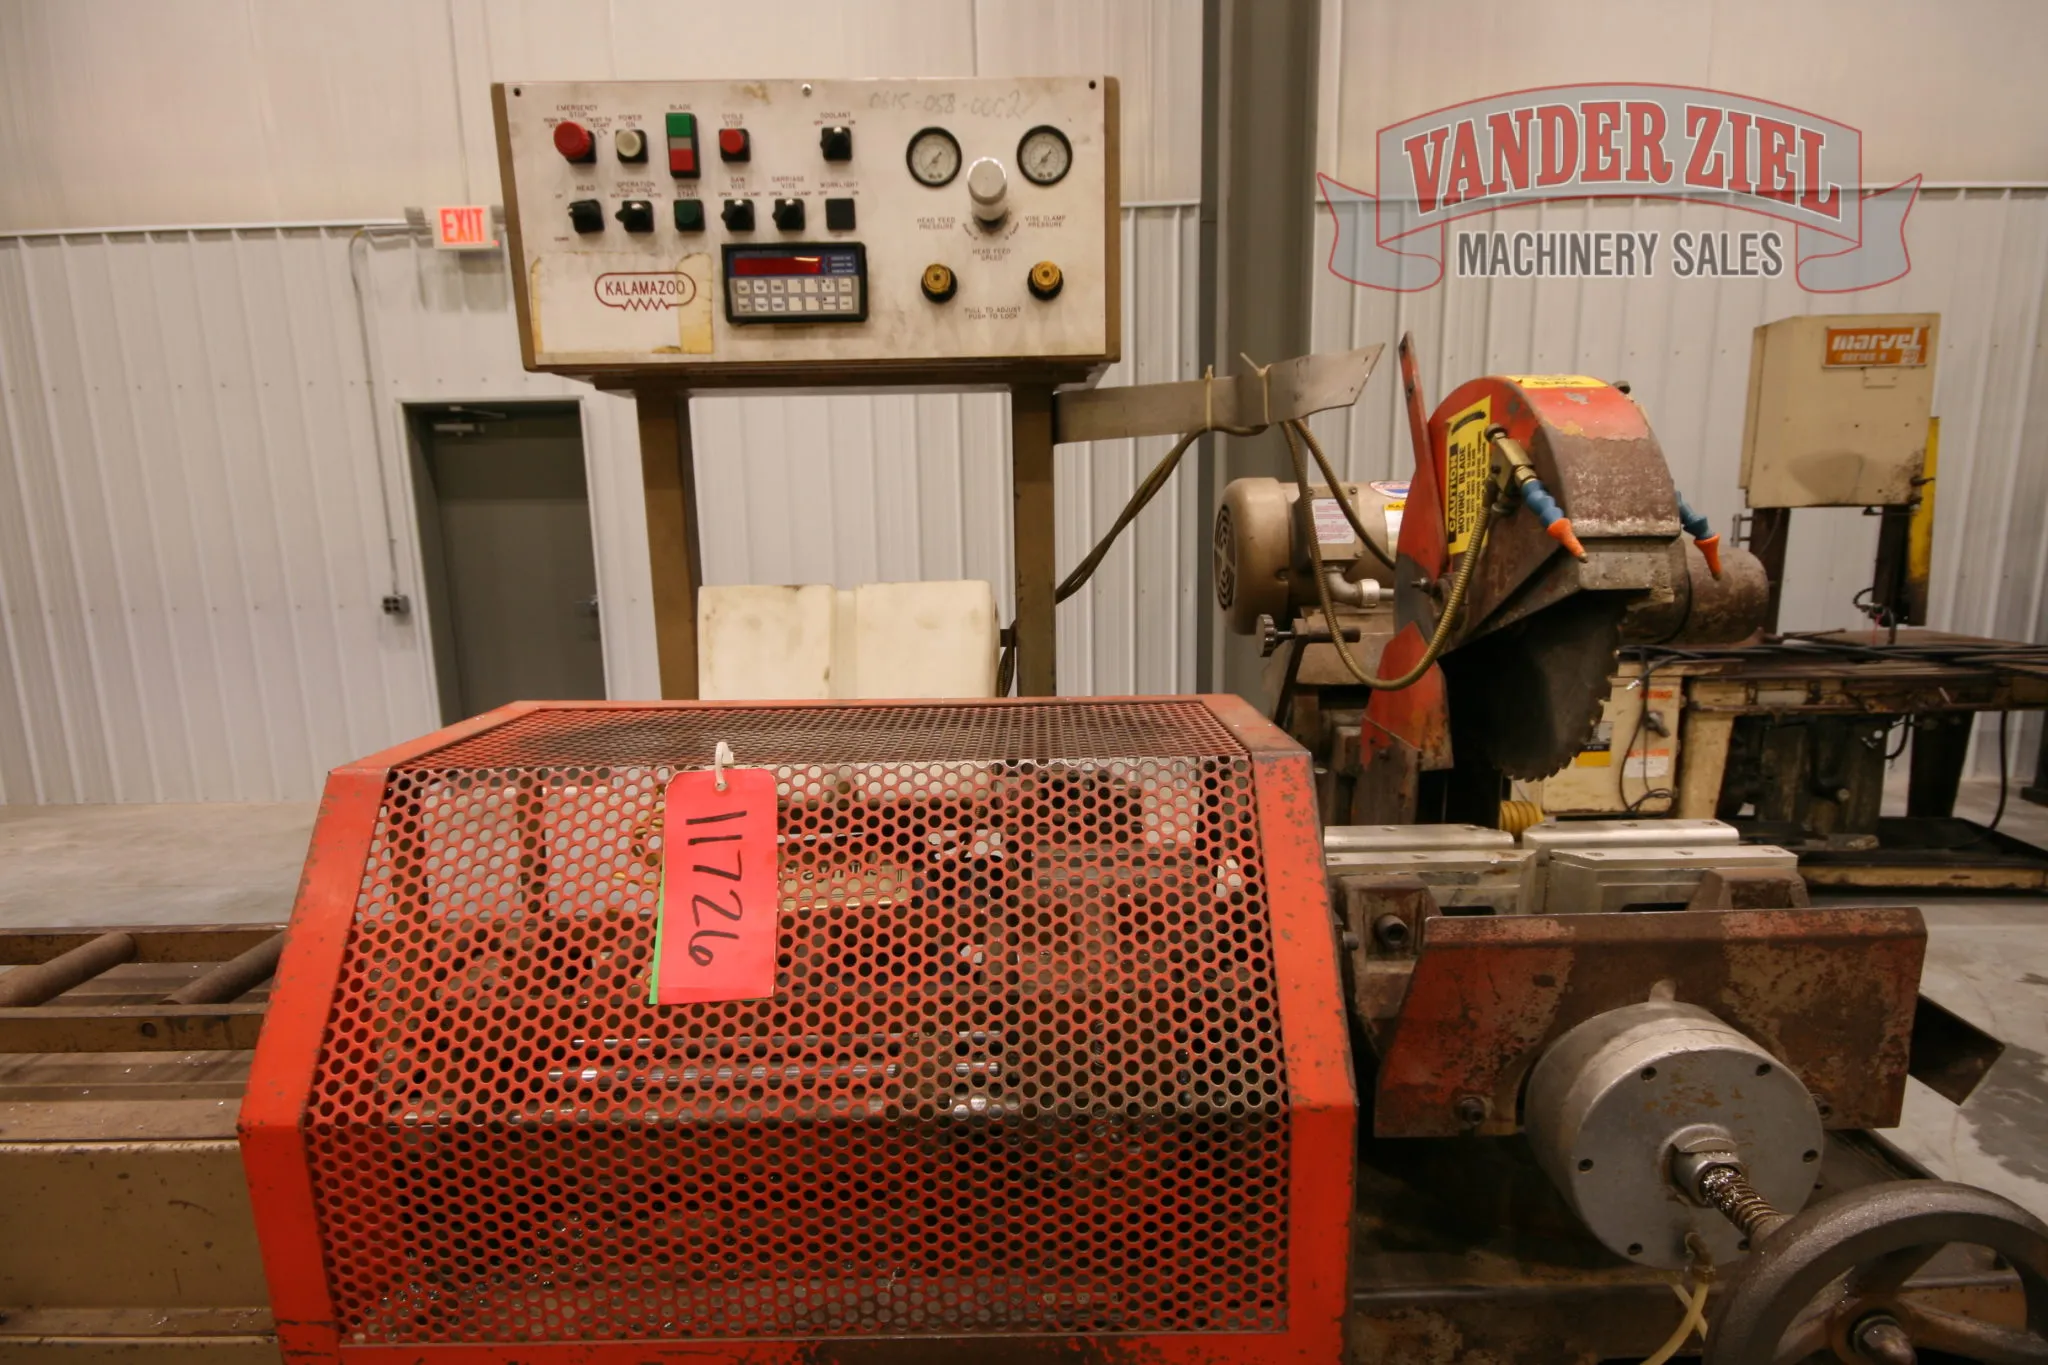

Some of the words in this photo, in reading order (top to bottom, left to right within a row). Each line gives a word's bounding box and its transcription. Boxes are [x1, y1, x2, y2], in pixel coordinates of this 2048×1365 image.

[556, 104, 598, 112] EMERGENCY
[820, 111, 851, 119] COOLANT
[440, 208, 484, 243] EXIT
[605, 280, 685, 296] KALAMAZOO
[1832, 327, 1921, 351] marvel
[1458, 446, 1466, 484] BLADE
[1449, 456, 1457, 532] CAUTION
[1457, 491, 1465, 534] MOVING
[686, 810, 747, 966] 11726
